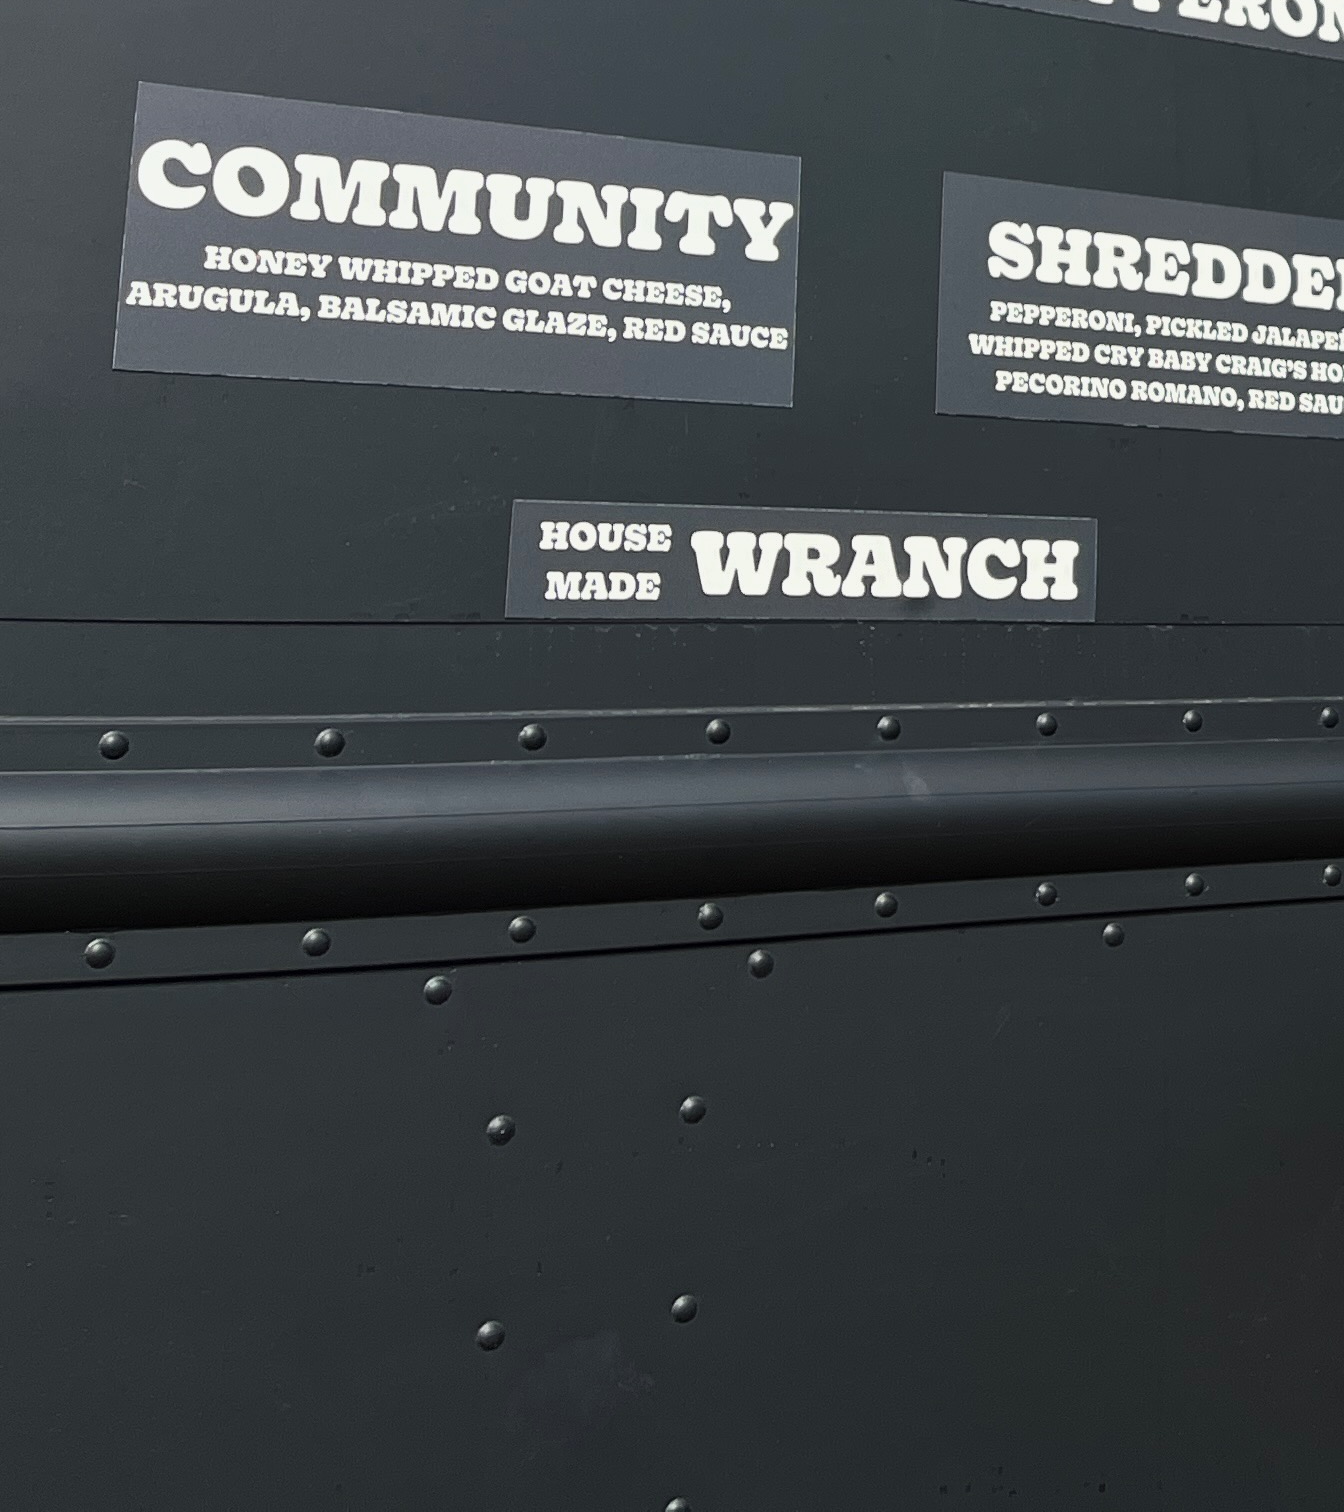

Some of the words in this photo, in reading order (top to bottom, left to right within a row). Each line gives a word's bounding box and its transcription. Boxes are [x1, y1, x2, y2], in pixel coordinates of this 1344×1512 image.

[137, 138, 794, 262] COMMUNITY
[203, 245, 333, 279] HONEY
[337, 255, 500, 291] WHIPPED
[504, 269, 598, 299] GOAT
[601, 277, 732, 314] CHEESE,
[125, 280, 311, 322] ARUGULA,
[317, 294, 498, 330] BALSAMIC
[502, 307, 617, 343] GLAZE,
[622, 316, 687, 343] RED
[691, 321, 789, 350] SAUCE
[989, 300, 1142, 338] PEPPERONI,
[1145, 314, 1249, 343] PICKLED
[968, 333, 1091, 363] WHIPPED
[1093, 343, 1145, 368] CRY
[1147, 347, 1213, 373] BABY
[1215, 353, 1308, 381] CRAIG'S
[994, 369, 1128, 400] PECORINO
[1130, 379, 1245, 412] ROMANO,
[1247, 388, 1296, 412] RED
[538, 521, 673, 552] HOUSE
[544, 570, 661, 601] MADE
[690, 530, 1080, 601] WRANCH
